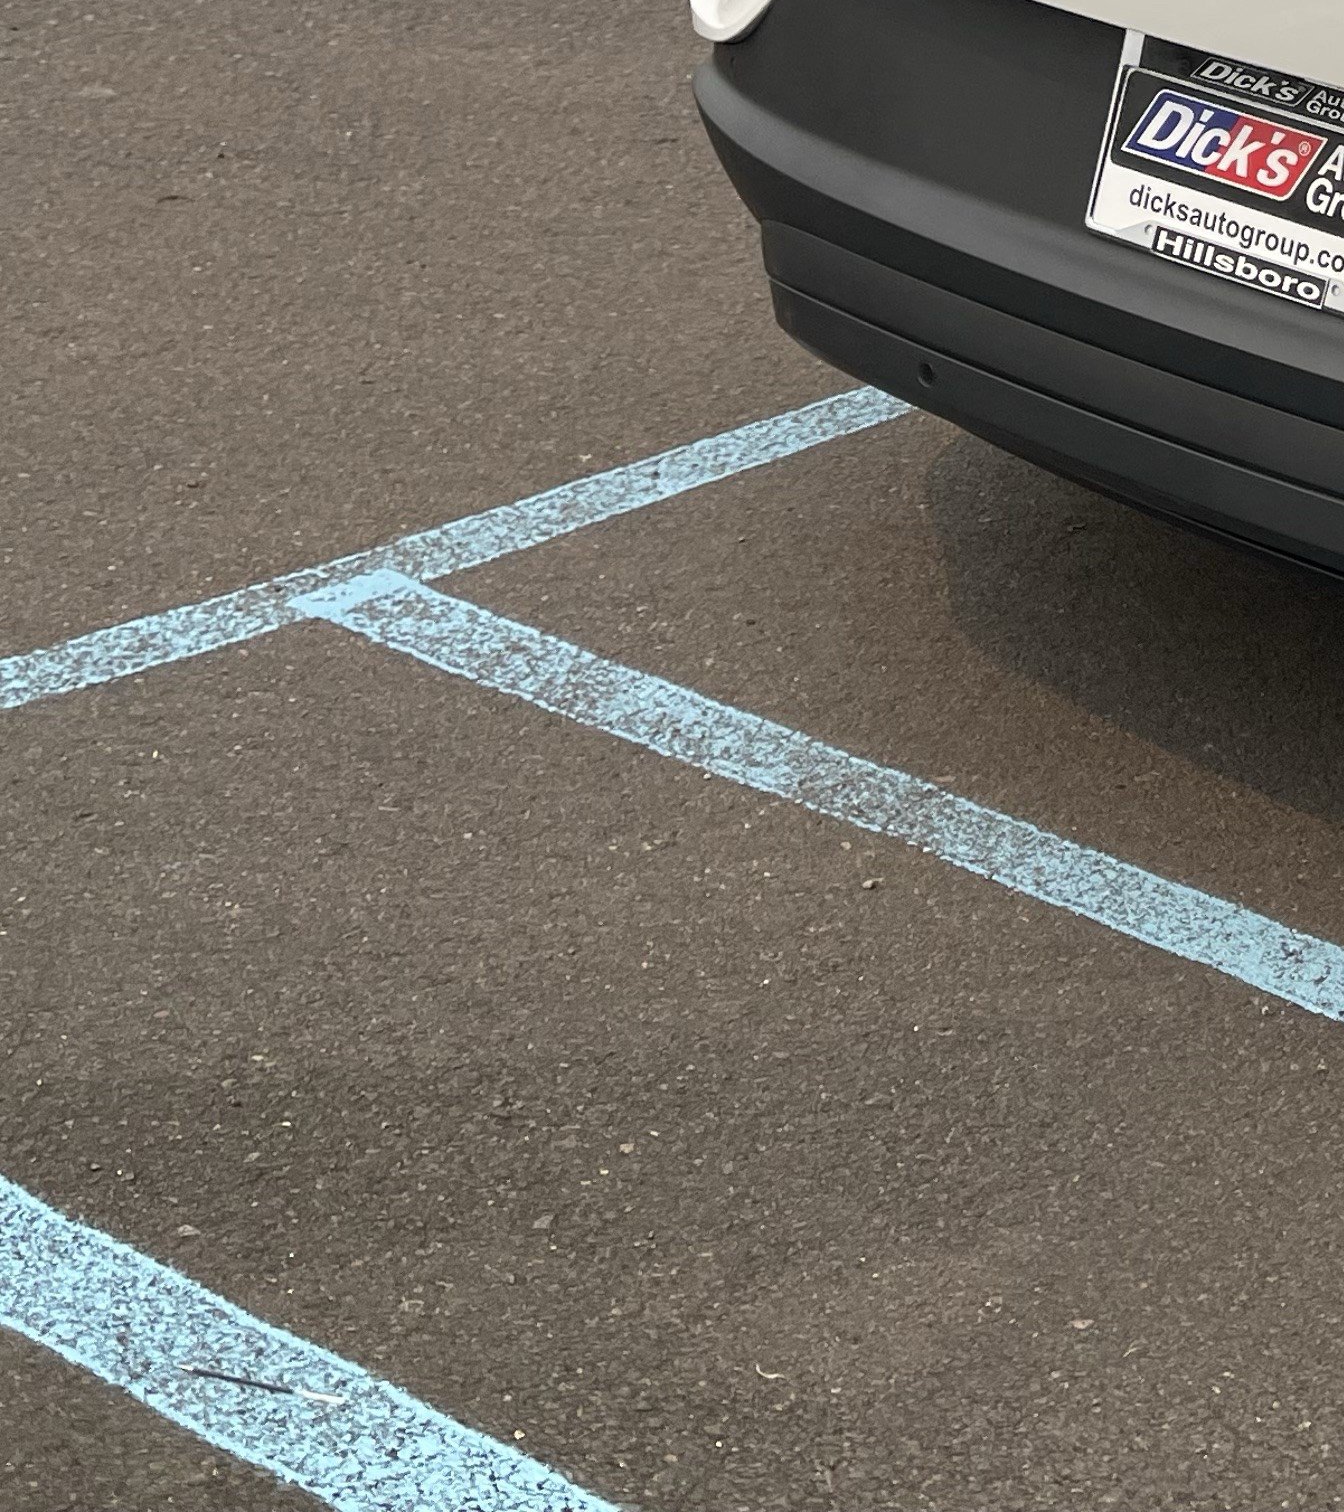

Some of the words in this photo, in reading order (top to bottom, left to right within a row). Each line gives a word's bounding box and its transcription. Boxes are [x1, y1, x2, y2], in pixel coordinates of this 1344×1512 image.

[1198, 57, 1302, 104] Dick's
[1136, 99, 1300, 189] Dick's
[1155, 228, 1322, 302] Hillsboro
